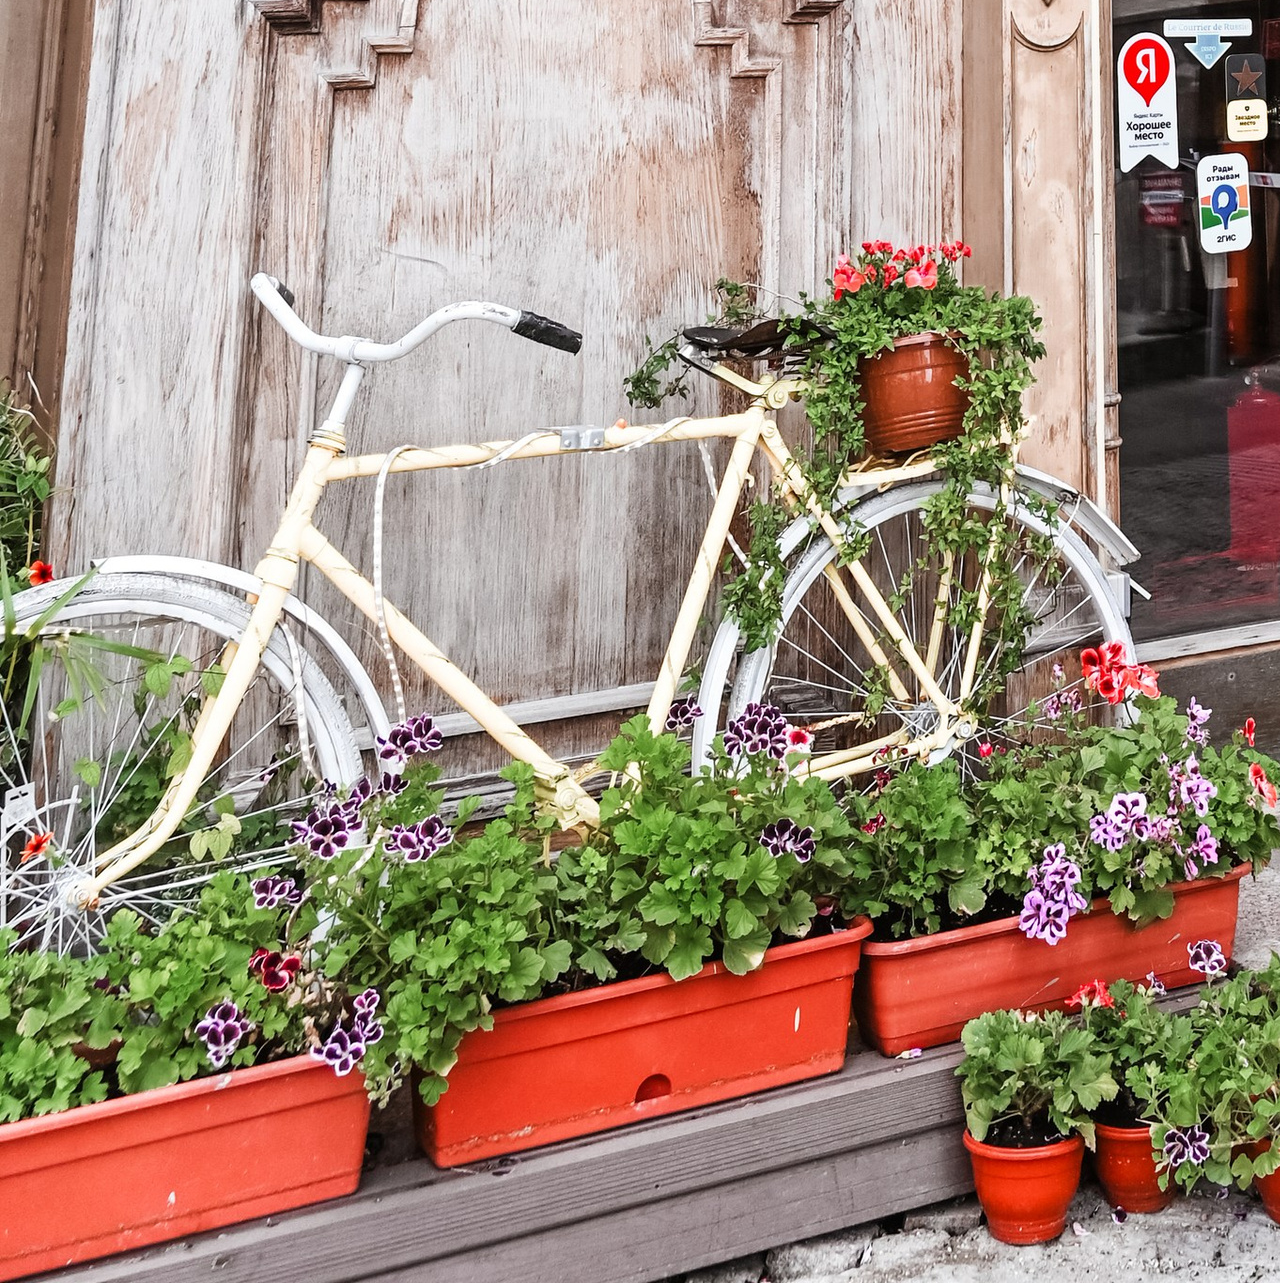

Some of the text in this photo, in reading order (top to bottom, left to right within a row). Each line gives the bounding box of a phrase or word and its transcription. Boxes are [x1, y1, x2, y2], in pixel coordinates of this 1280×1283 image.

[1212, 23, 1223, 31] de
[1135, 47, 1157, 84] Я
[1125, 120, 1172, 133] Хорошее
[1134, 131, 1165, 141] место
[1212, 165, 1234, 174] Рады
[1206, 173, 1241, 183] отзывам
[1216, 234, 1237, 244] 2ГИС
